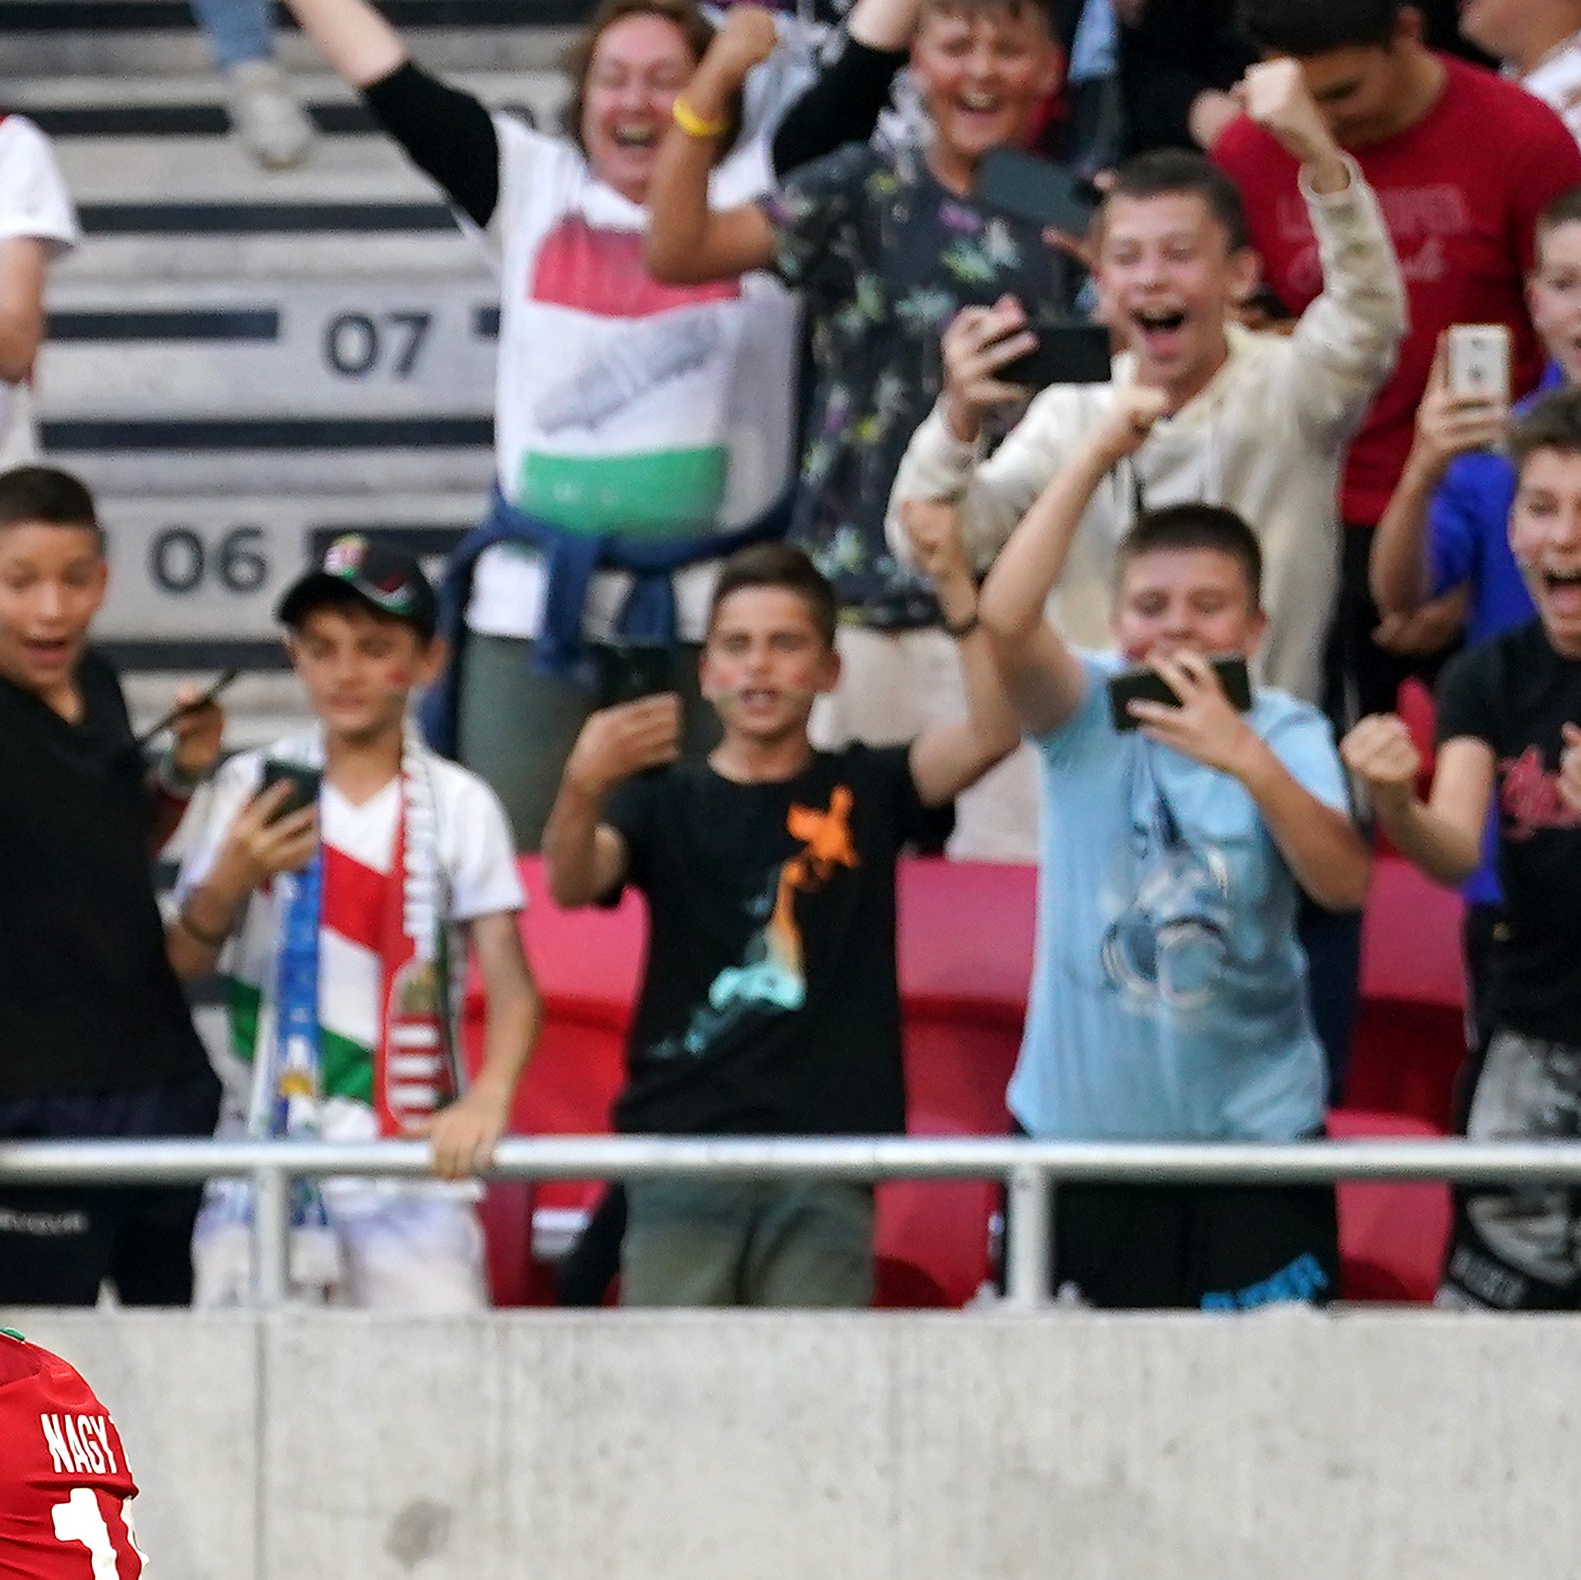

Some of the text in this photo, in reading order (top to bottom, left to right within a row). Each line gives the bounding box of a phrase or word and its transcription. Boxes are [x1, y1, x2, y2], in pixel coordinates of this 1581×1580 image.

[324, 309, 431, 377] 07
[149, 526, 269, 594] 06
[41, 1413, 118, 1474] NAGY
